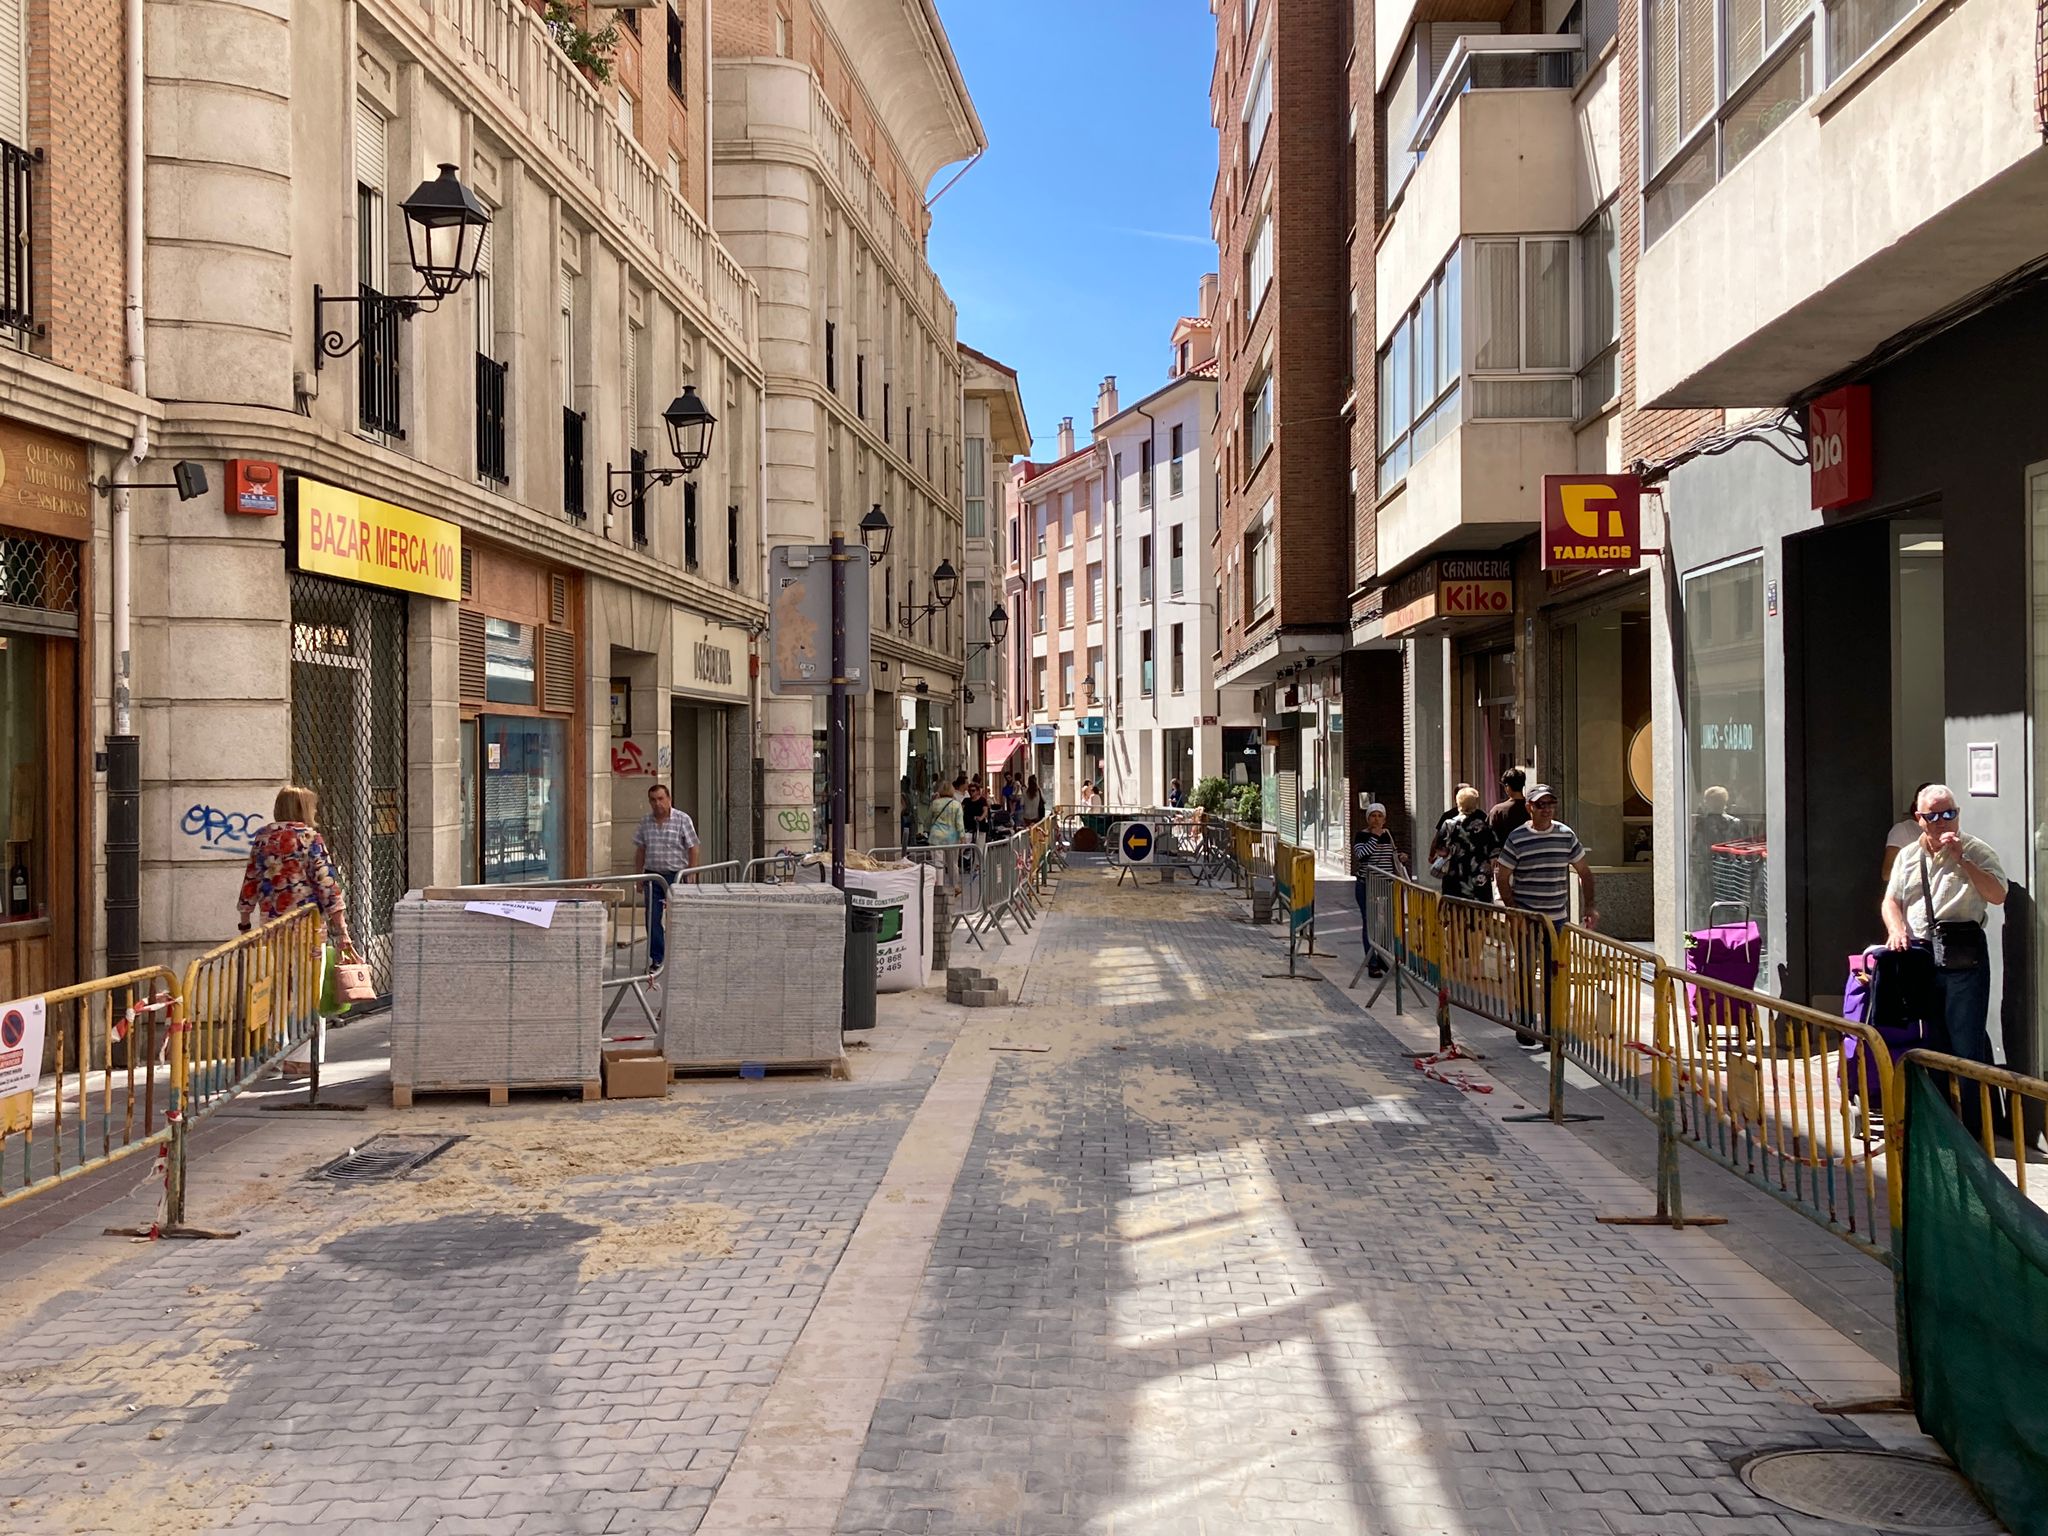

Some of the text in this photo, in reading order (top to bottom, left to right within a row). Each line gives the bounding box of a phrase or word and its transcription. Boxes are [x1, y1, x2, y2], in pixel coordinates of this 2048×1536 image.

[18, 489, 87, 518] CNSERVAS
[310, 508, 454, 582] BAZAR MERCA 100
[1553, 545, 1632, 560] TABACOS
[1442, 560, 1511, 578] CARNICERIA
[1446, 584, 1508, 611] Kiko
